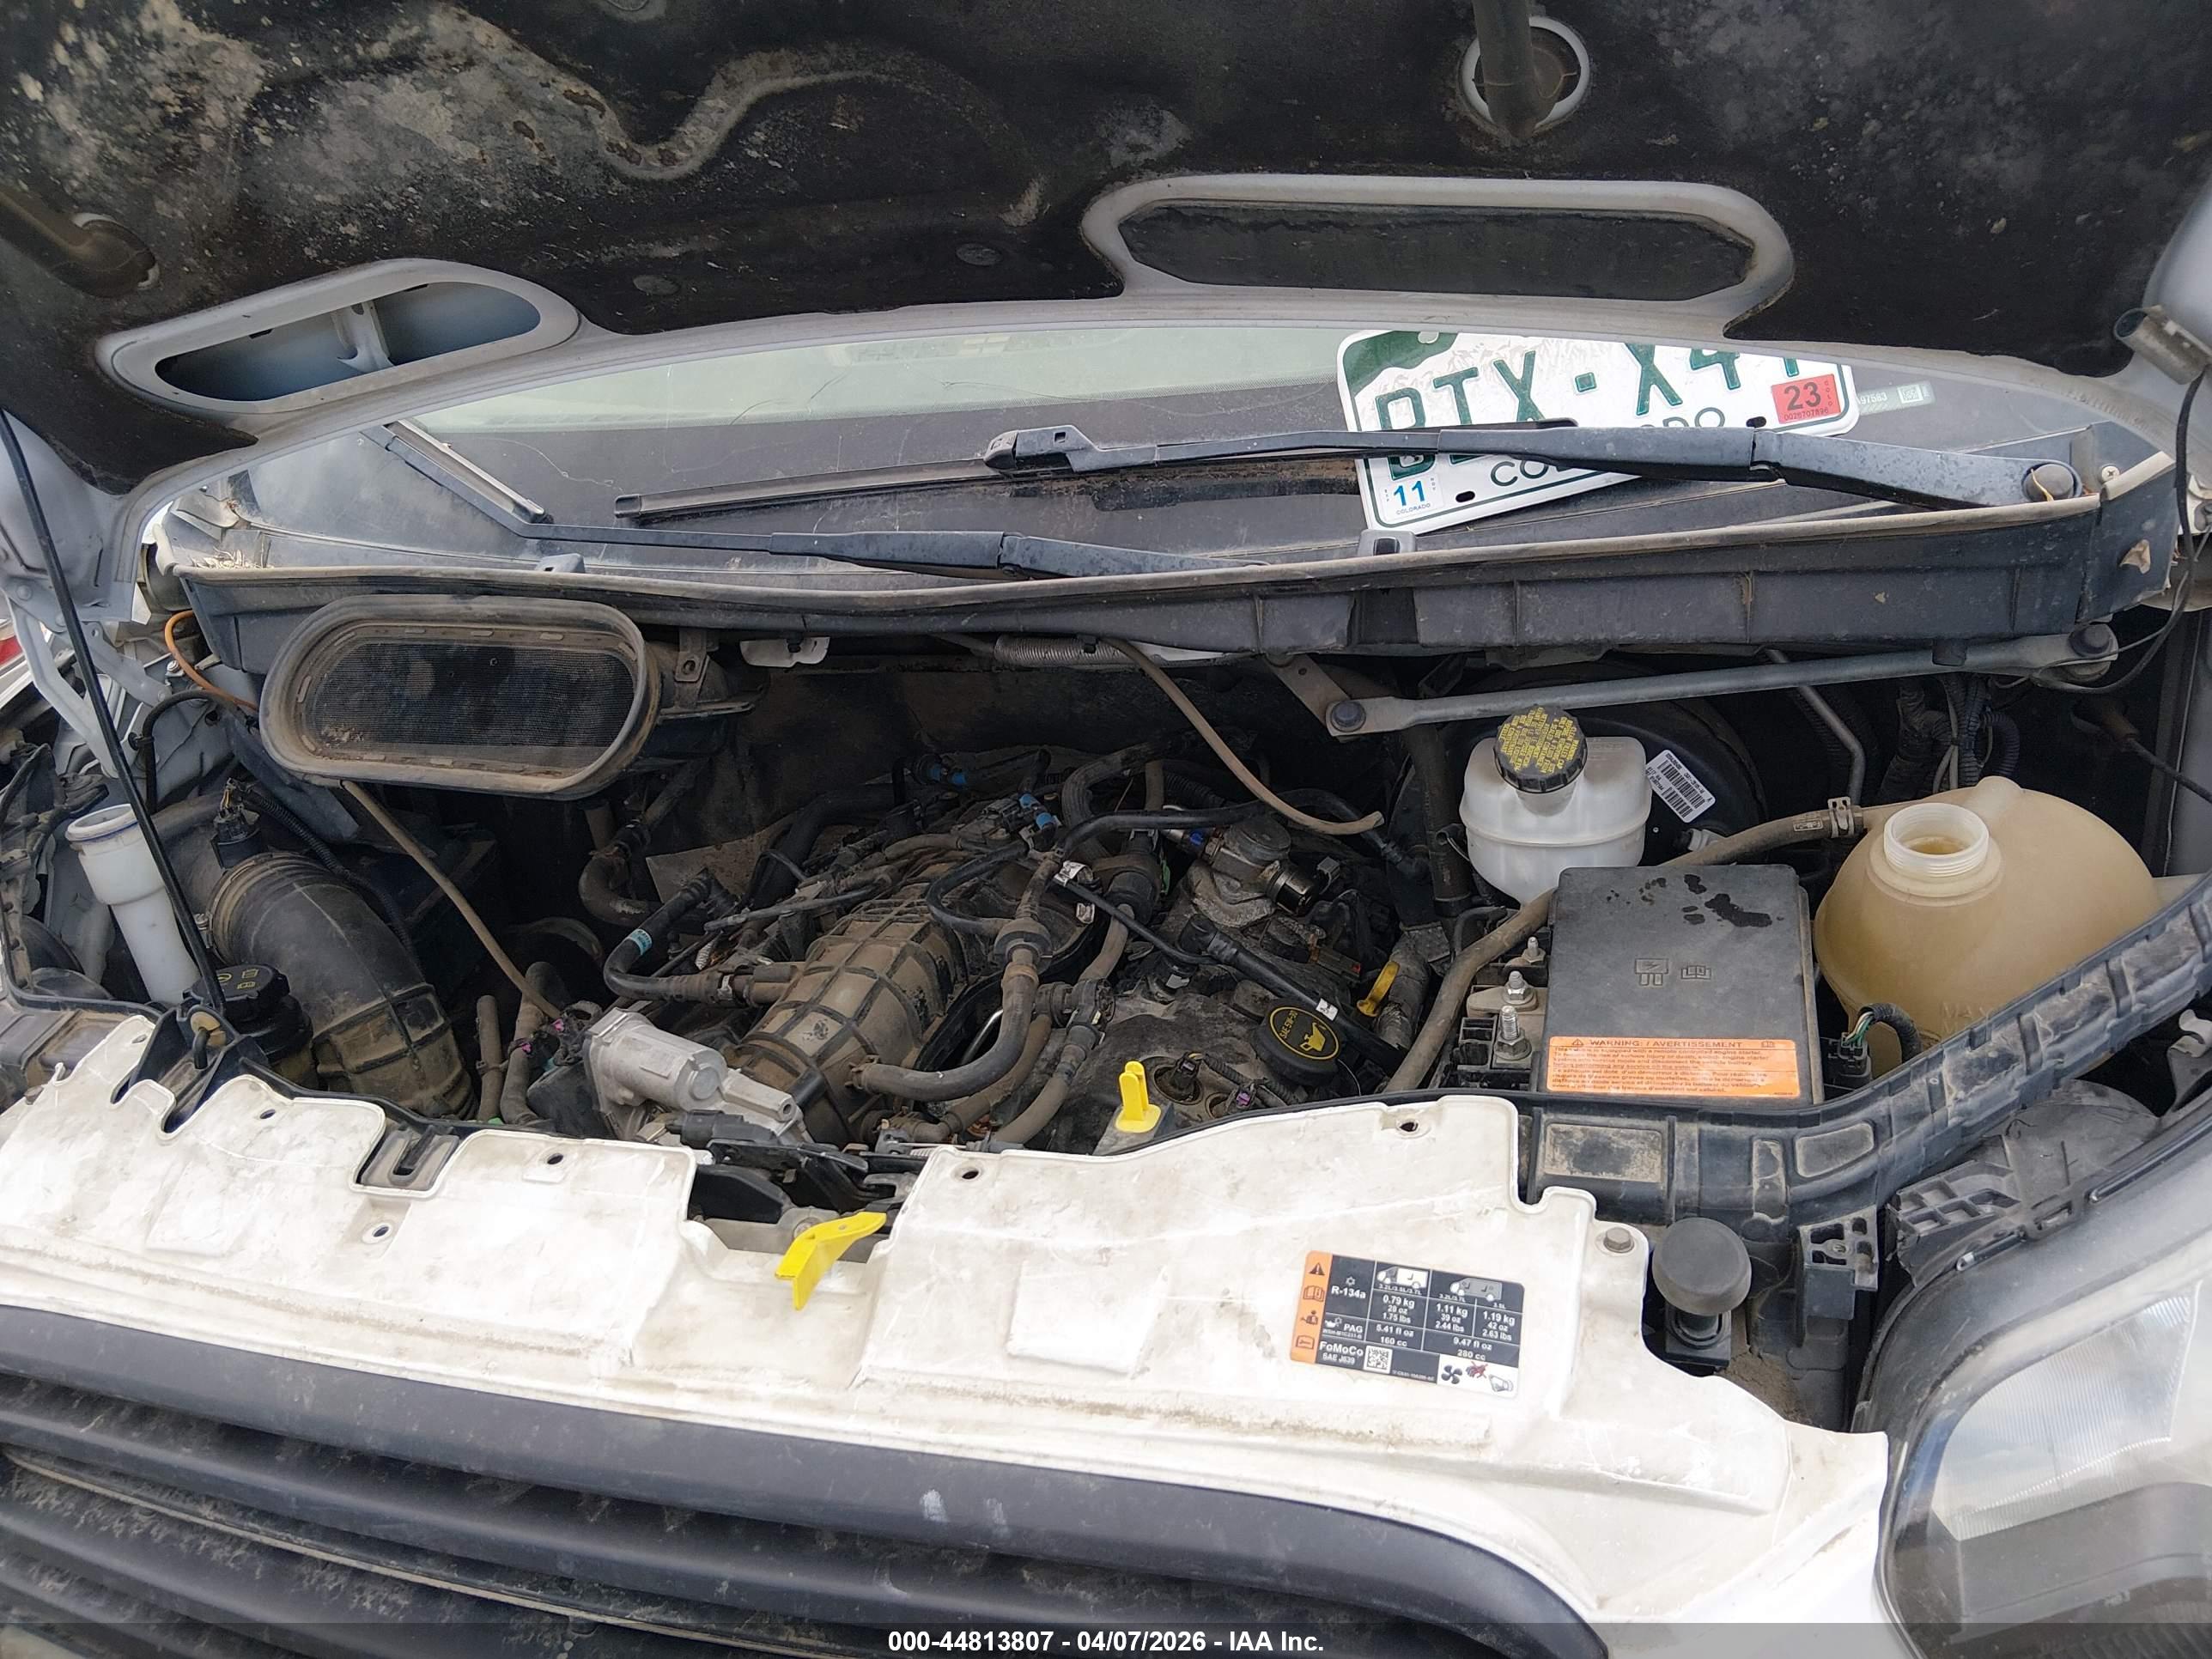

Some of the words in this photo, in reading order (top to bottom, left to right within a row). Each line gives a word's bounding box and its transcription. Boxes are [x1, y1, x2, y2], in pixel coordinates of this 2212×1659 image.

[1784, 380, 1822, 412] 23
[1392, 479, 1426, 507] 11
[1395, 501, 1432, 516] COLORADO
[1331, 1285, 1365, 1299] R-134a
[1382, 1293, 1401, 1305] 0.79
[1402, 1297, 1414, 1310] kg
[1387, 1304, 1396, 1312] 28
[1382, 1311, 1397, 1321] 1.75
[1399, 1315, 1411, 1323] lbs
[1436, 1303, 1453, 1314] 1.11
[1455, 1306, 1468, 1318] kg
[1483, 1310, 1501, 1322] 1.19
[1503, 1314, 1515, 1326] kg
[1343, 1322, 1363, 1334] PAG
[1376, 1323, 1393, 1334] 5.41
[1403, 1328, 1413, 1338] oz
[1435, 1320, 1451, 1330] 2.44
[1452, 1323, 1464, 1332] lbs
[1487, 1321, 1497, 1329] 42
[1481, 1328, 1498, 1339] 2.63
[1499, 1331, 1511, 1340] lbs
[1380, 1336, 1395, 1345] 160
[1396, 1339, 1407, 1347] cc
[1453, 1336, 1471, 1346] 9.47
[1319, 1340, 1364, 1357] FoMoCo
[1457, 1348, 1473, 1358] 280
